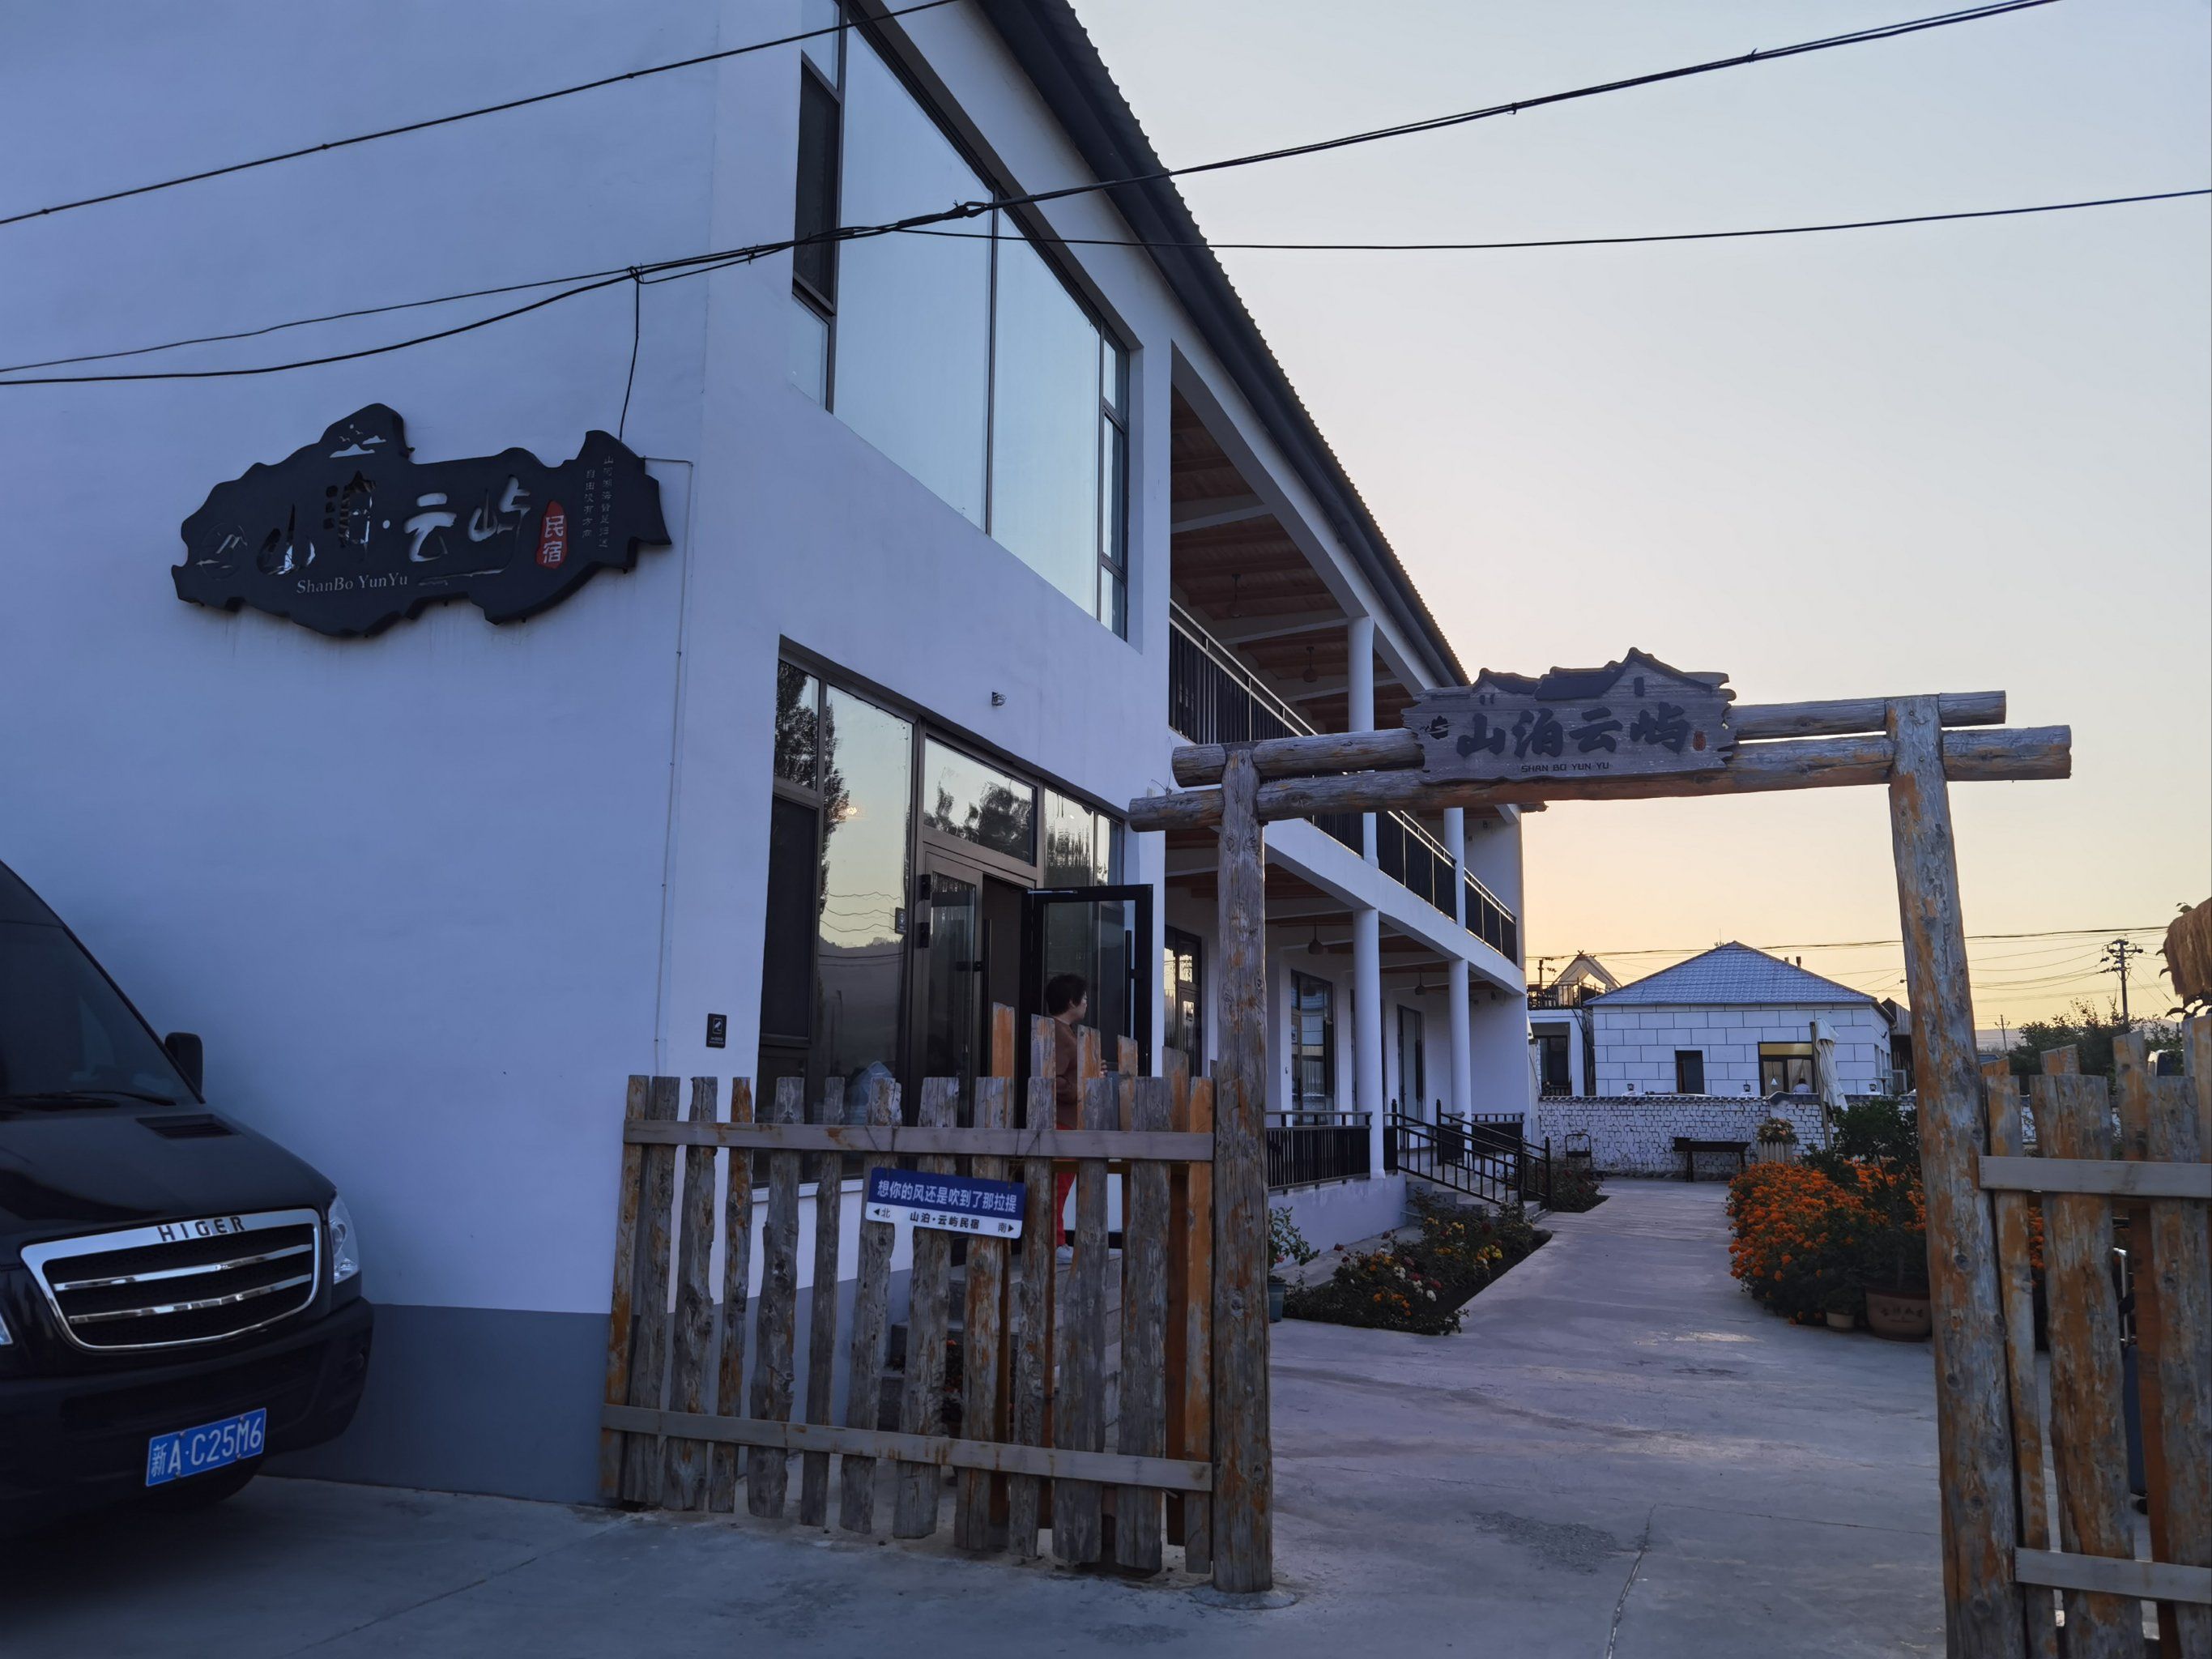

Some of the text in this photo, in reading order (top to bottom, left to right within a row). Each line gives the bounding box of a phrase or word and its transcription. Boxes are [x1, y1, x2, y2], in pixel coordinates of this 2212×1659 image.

[543, 514, 565, 564] 民宿
[296, 564, 407, 594] ShanBo YunYu
[1457, 702, 1690, 758] 山泊云屿
[1521, 761, 1609, 773] SHAN BO YUN YU
[876, 1179, 1017, 1213] 想你的风还是吹到了那拉提
[157, 1217, 245, 1242] HIGER
[881, 1208, 890, 1218] 北
[997, 1222, 1007, 1234] 南
